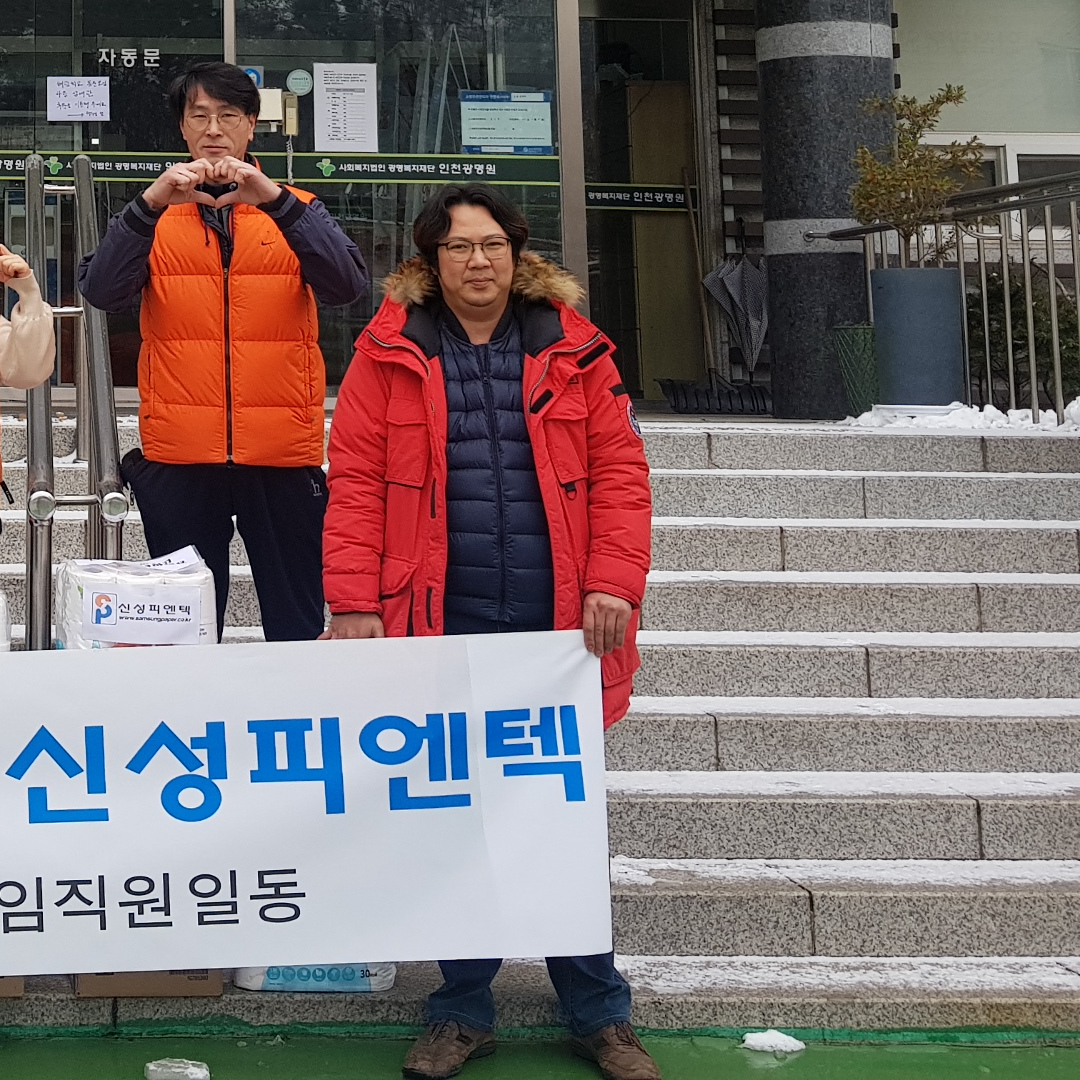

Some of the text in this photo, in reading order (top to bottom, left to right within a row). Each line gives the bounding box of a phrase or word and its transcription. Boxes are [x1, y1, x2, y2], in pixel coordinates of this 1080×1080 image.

[98, 47, 161, 68] 자동문
[114, 162, 163, 172] 광명복지재단
[338, 163, 497, 175] 사회복지법인 광명복지재단 인천광명원
[632, 191, 685, 204] 인천광명원
[118, 603, 191, 616] 신성피엔텍
